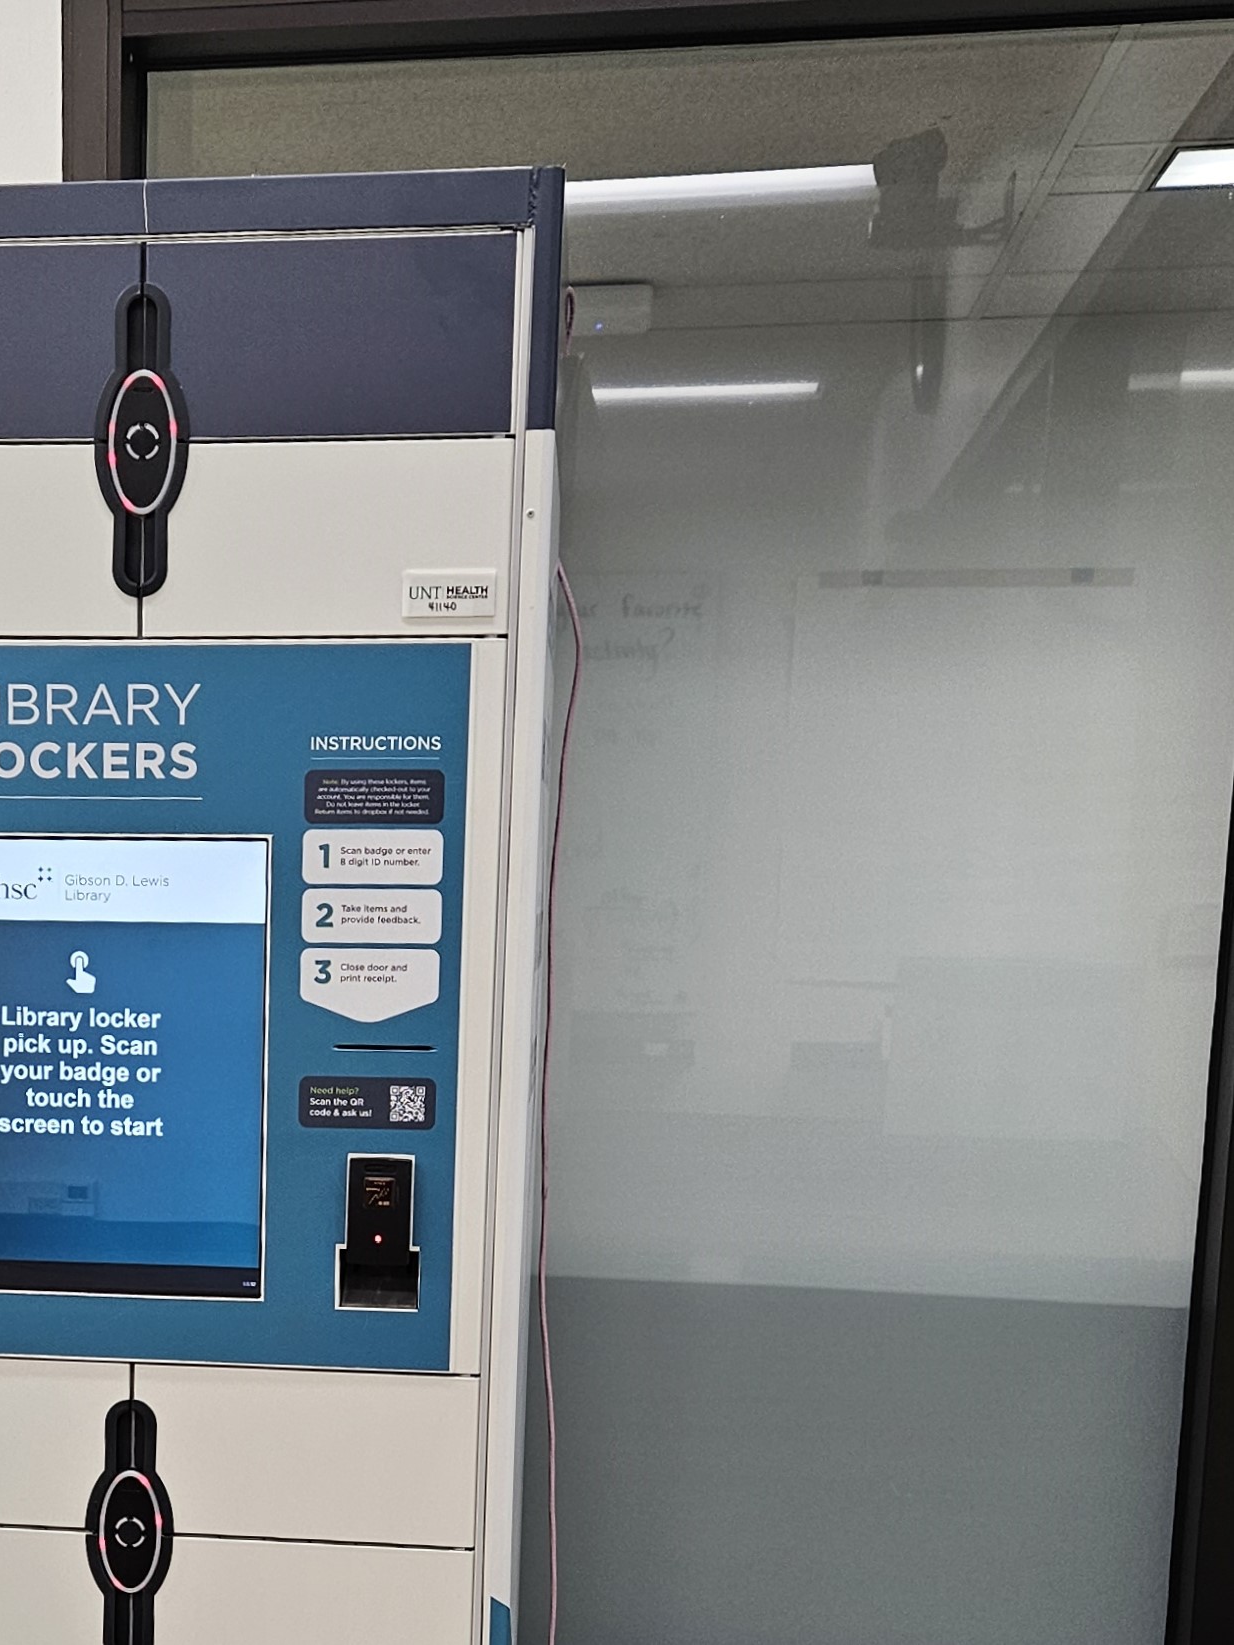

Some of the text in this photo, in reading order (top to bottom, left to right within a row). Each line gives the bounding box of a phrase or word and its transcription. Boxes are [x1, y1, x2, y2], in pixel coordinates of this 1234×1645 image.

[409, 585, 489, 600] UNT HEALTH
[310, 735, 442, 751] INSTRUCTIONS
[318, 843, 330, 869] 1
[340, 846, 363, 855] Scan
[364, 846, 393, 857] badge
[407, 846, 432, 856] enter
[340, 858, 421, 868] 8 digit ID number.
[64, 874, 170, 887] Gibson D. Lewis
[64, 889, 111, 903] Library
[315, 902, 334, 928] 2
[341, 904, 408, 913] Take items and
[341, 915, 421, 925] provide feedback.
[313, 959, 332, 985] 3
[340, 963, 408, 972] Close door and
[340, 974, 398, 984] print receipt.
[1, 1005, 162, 1032] Library locker
[3, 1033, 158, 1059] pick up. Scan
[0, 1060, 162, 1087] your badge or
[309, 1086, 359, 1096] Need help?
[26, 1088, 135, 1109] touch the
[309, 1097, 365, 1106] Scan the QR
[309, 1108, 373, 1117] code & ask us!
[81, 1115, 105, 1136] to
[110, 1116, 164, 1137] start
